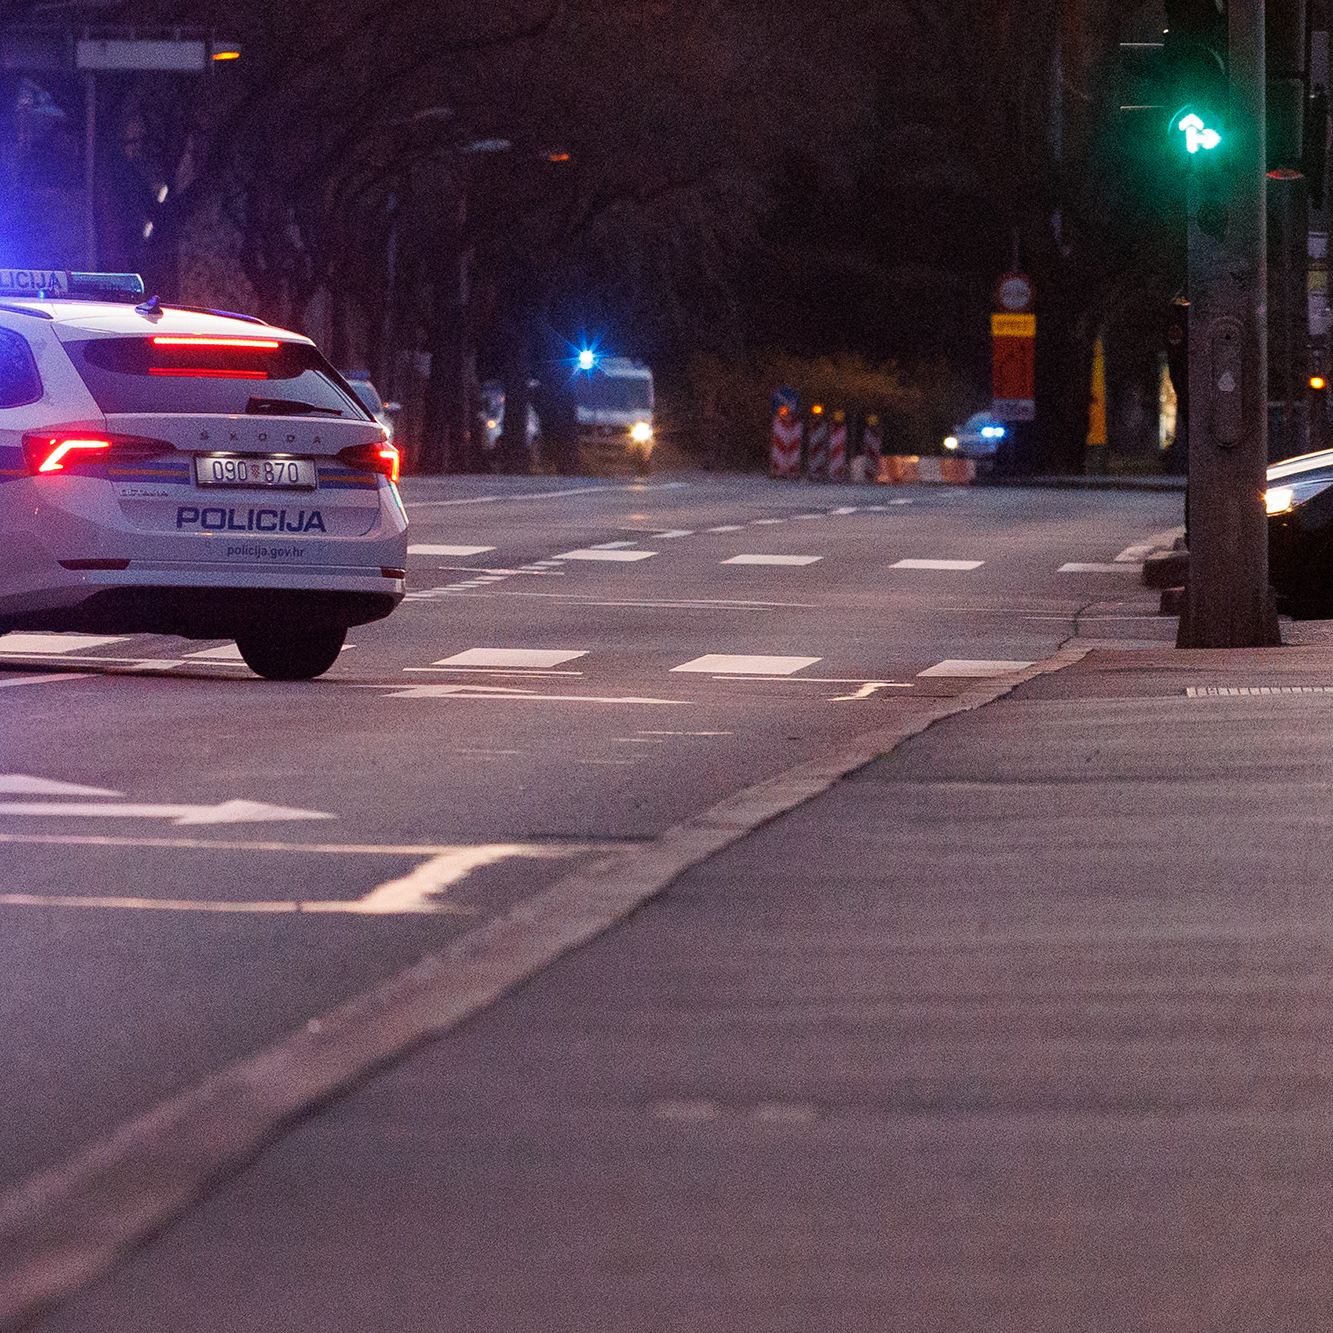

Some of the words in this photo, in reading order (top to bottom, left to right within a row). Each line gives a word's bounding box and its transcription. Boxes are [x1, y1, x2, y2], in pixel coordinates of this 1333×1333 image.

[212, 460, 248, 483] 090
[263, 462, 300, 484] 870
[176, 506, 327, 532] POLICIJA
[226, 543, 306, 559] policija.gov.hr
